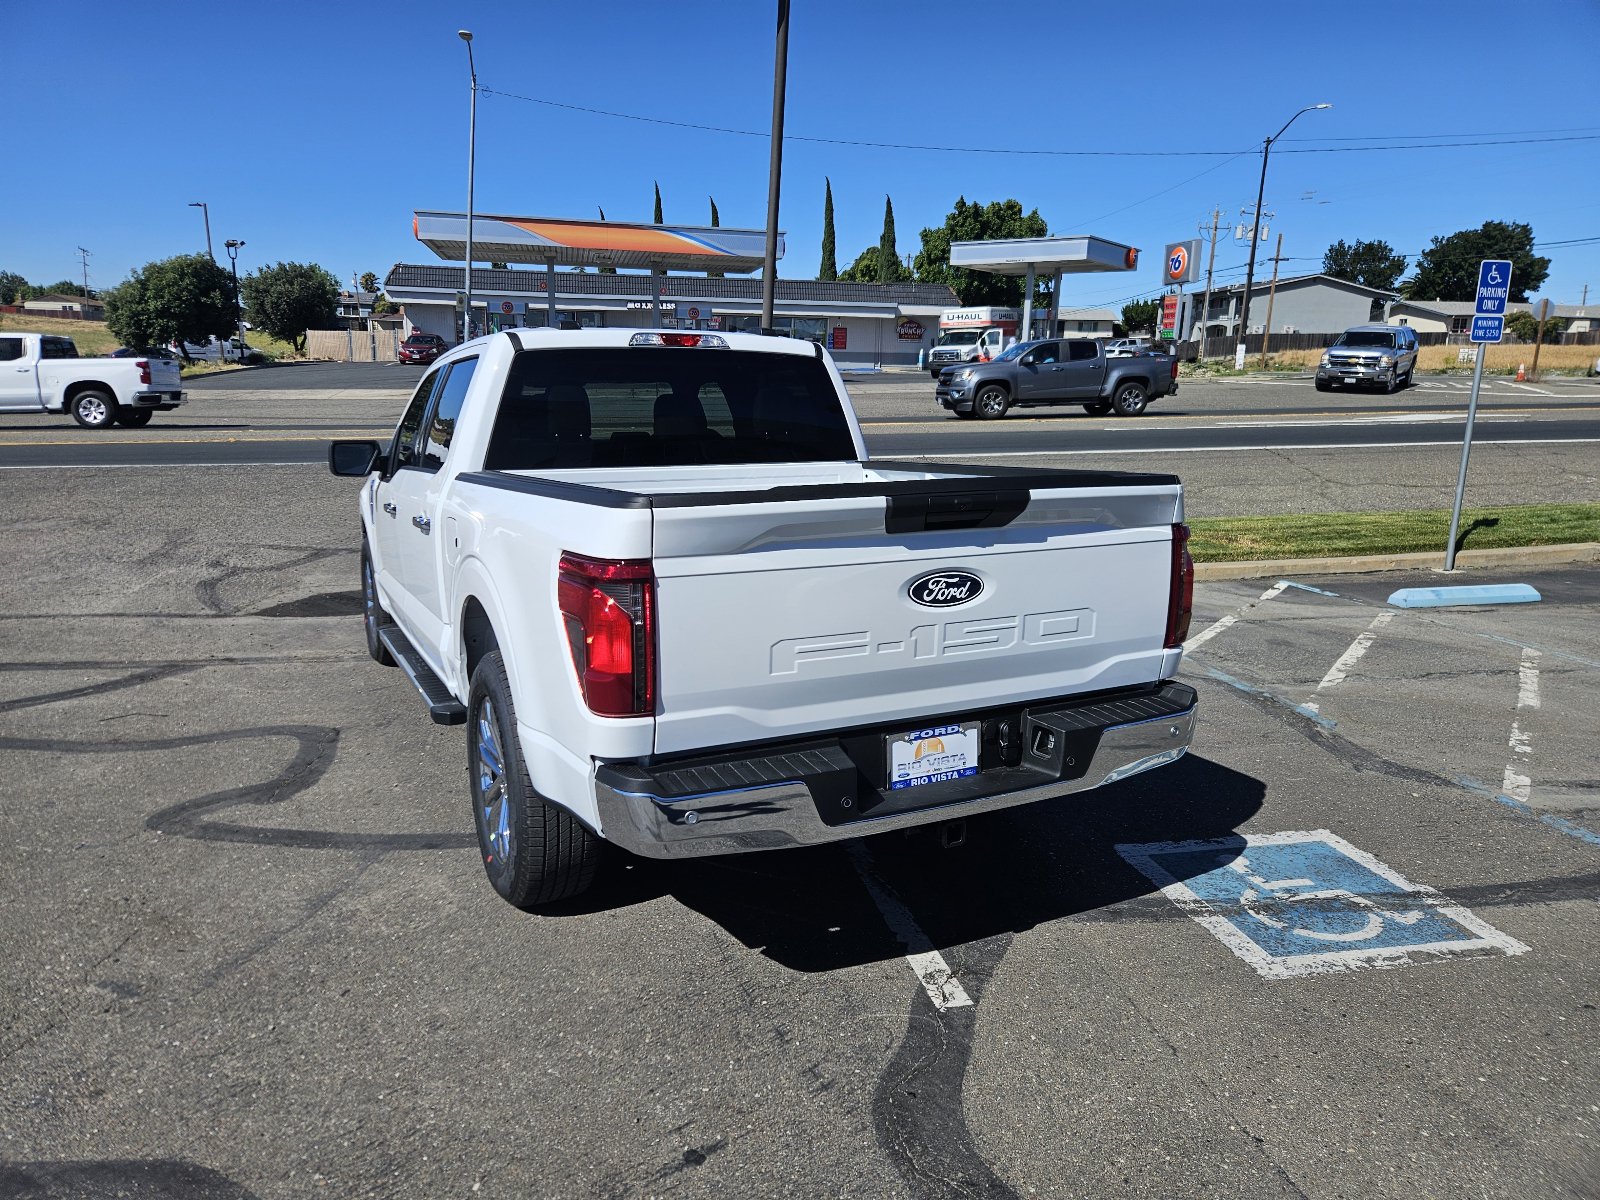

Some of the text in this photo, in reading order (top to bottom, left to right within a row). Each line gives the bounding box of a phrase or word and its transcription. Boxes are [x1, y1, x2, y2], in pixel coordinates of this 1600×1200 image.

[1168, 253, 1182, 273] 76
[1479, 287, 1506, 298] PARKING
[1482, 300, 1499, 310] ONLY
[1474, 329, 1499, 338] FINE $250
[923, 577, 971, 601] Ford
[769, 607, 1097, 676] F-150
[909, 725, 959, 740] FORD
[911, 772, 959, 787] RIO VISTA
